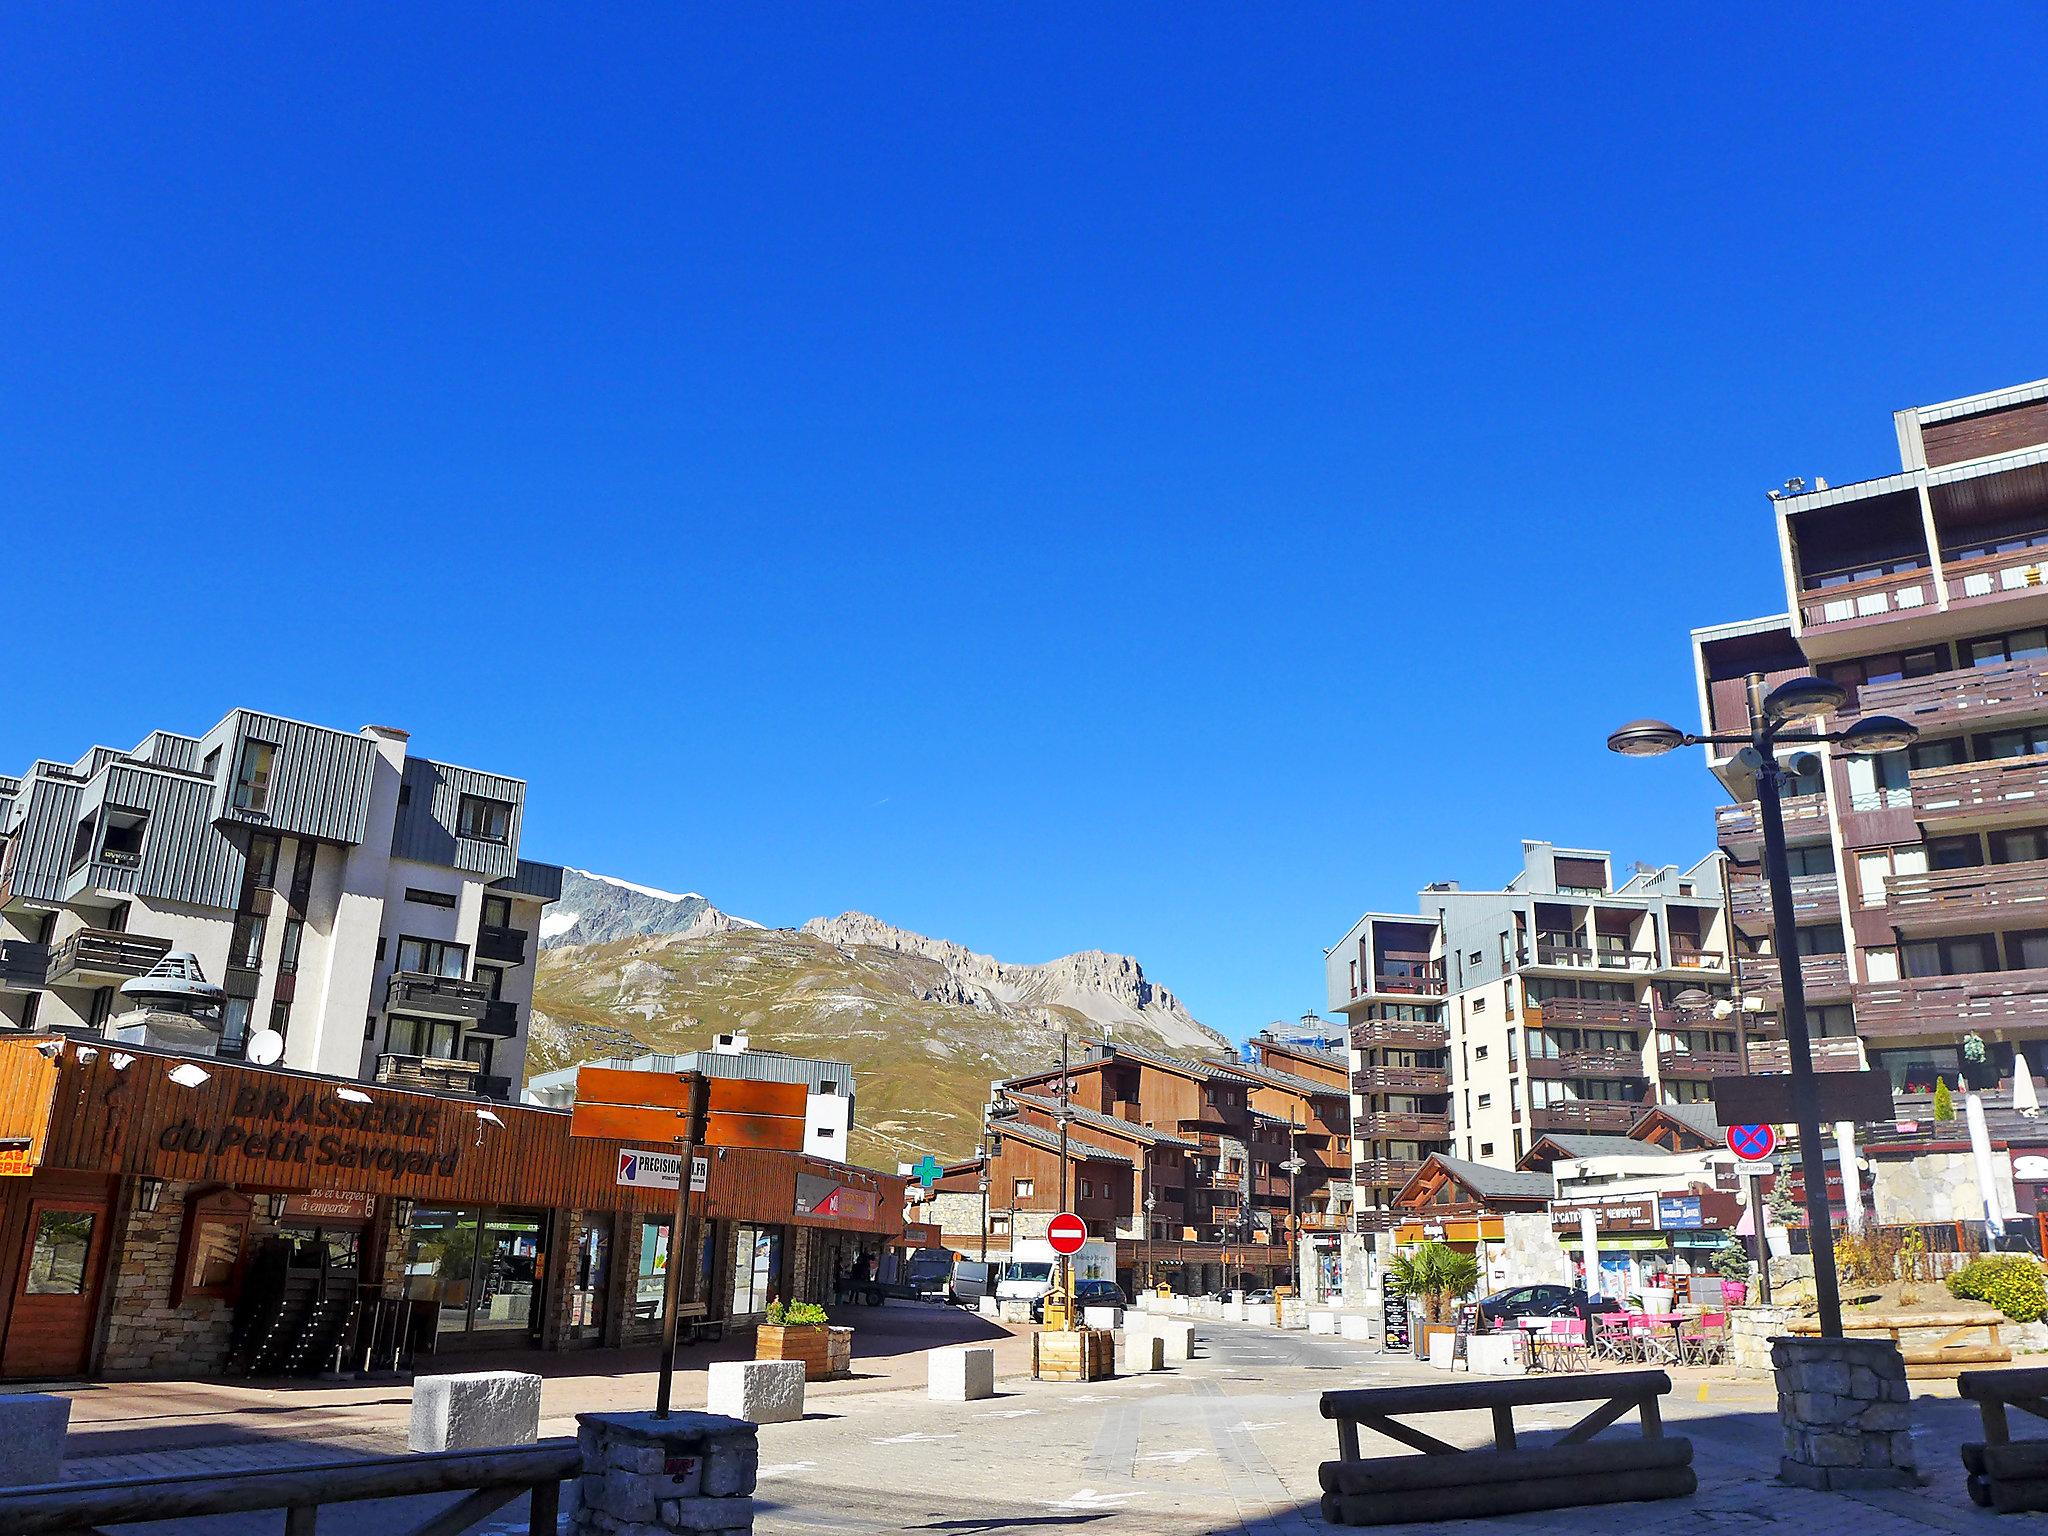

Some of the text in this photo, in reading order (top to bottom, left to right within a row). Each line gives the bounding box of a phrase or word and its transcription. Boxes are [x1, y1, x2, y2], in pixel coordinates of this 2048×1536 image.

[233, 1086, 441, 1138] BRASSERIE
[160, 1119, 459, 1180] du Petit Savoyard
